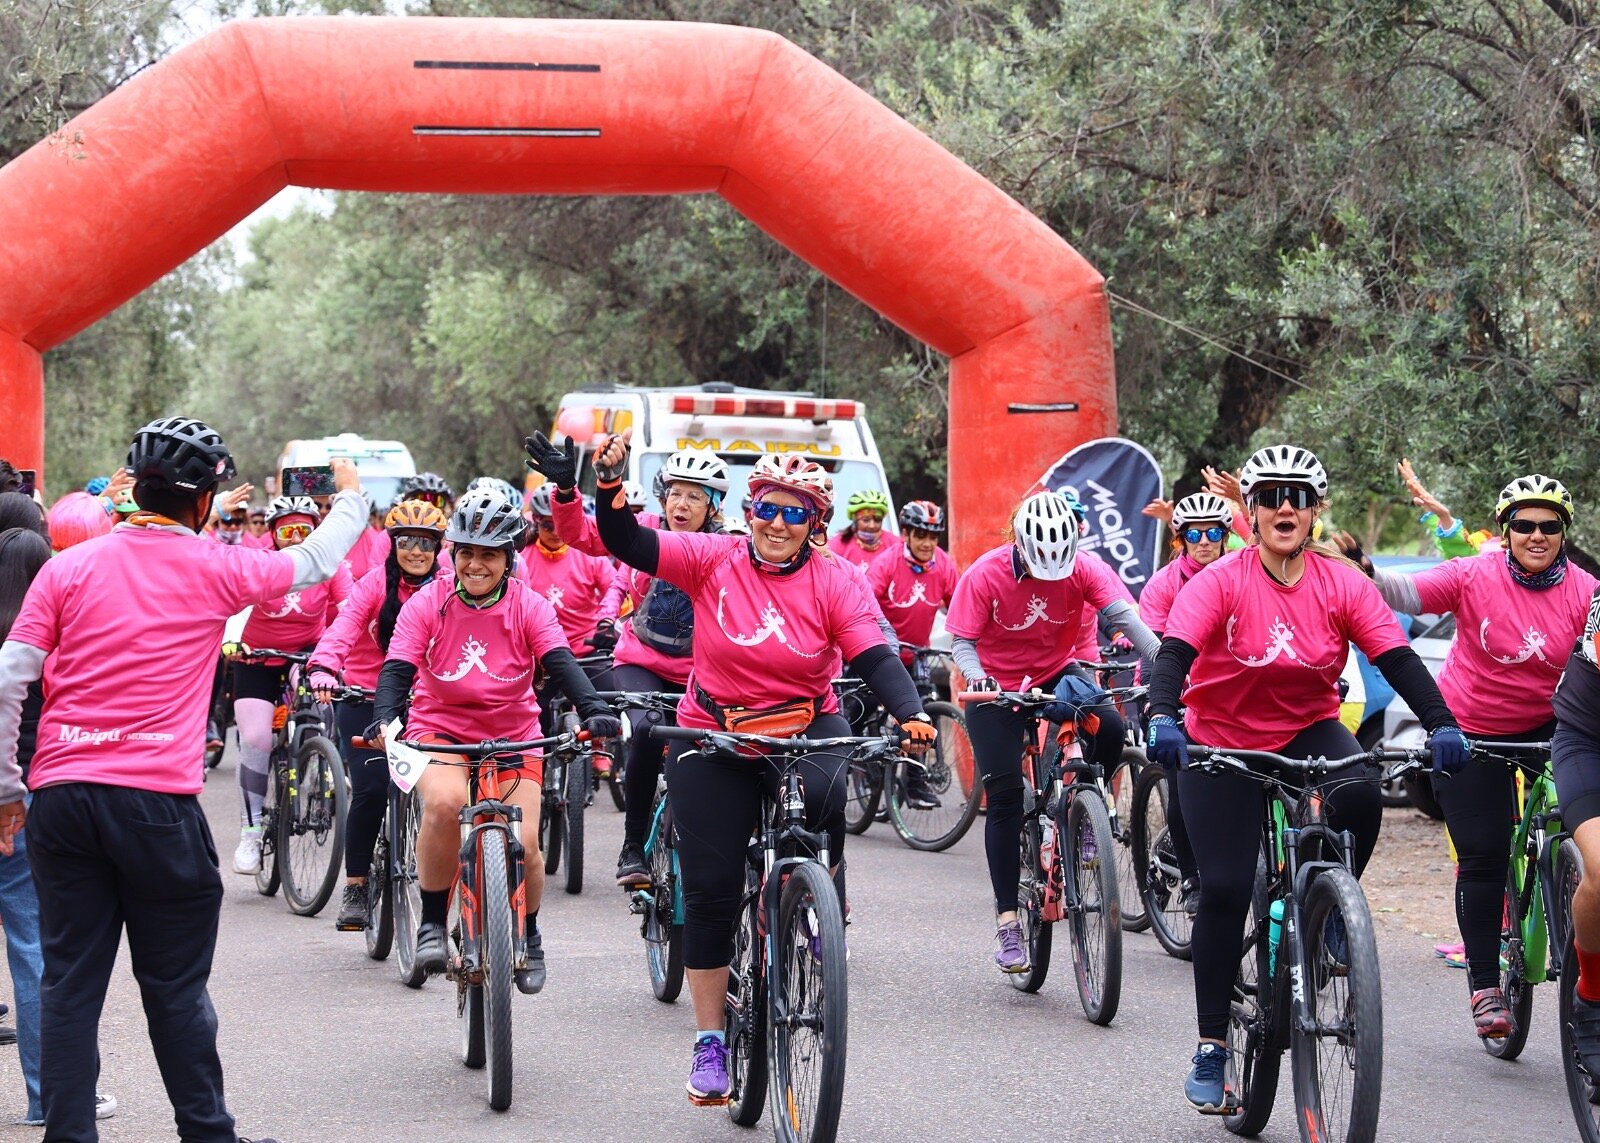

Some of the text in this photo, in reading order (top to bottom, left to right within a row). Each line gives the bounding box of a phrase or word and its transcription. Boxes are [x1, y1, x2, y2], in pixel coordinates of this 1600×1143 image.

[676, 438, 842, 456] MAIPU
[1086, 479, 1146, 585] Maipu
[1290, 964, 1304, 1004] FOX
